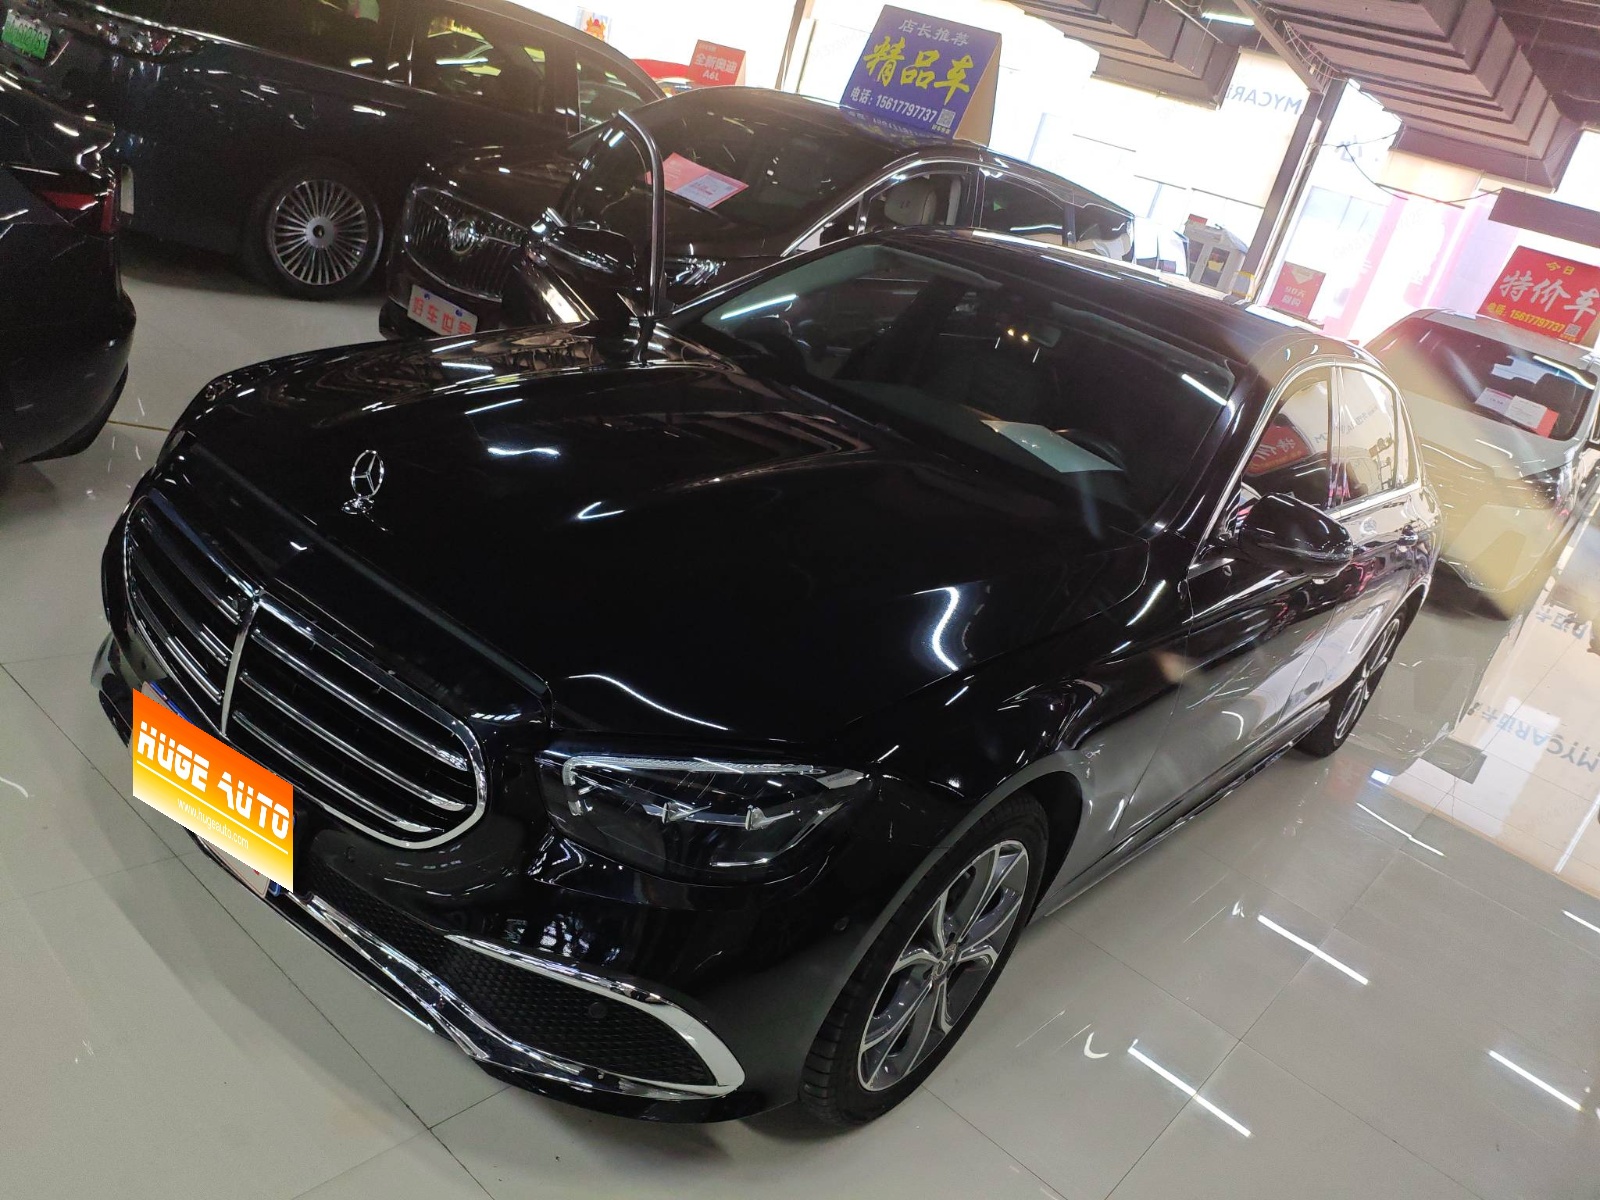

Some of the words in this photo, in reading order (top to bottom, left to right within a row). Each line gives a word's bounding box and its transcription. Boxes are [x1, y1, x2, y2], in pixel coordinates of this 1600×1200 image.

[899, 19, 969, 46] 店长推荐
[702, 70, 719, 81] A6L
[863, 36, 974, 105] 精品车
[875, 94, 938, 123] 15617797737
[1546, 262, 1575, 276] 今日
[1500, 270, 1600, 323] 特价车
[1509, 309, 1566, 332] 15617797737
